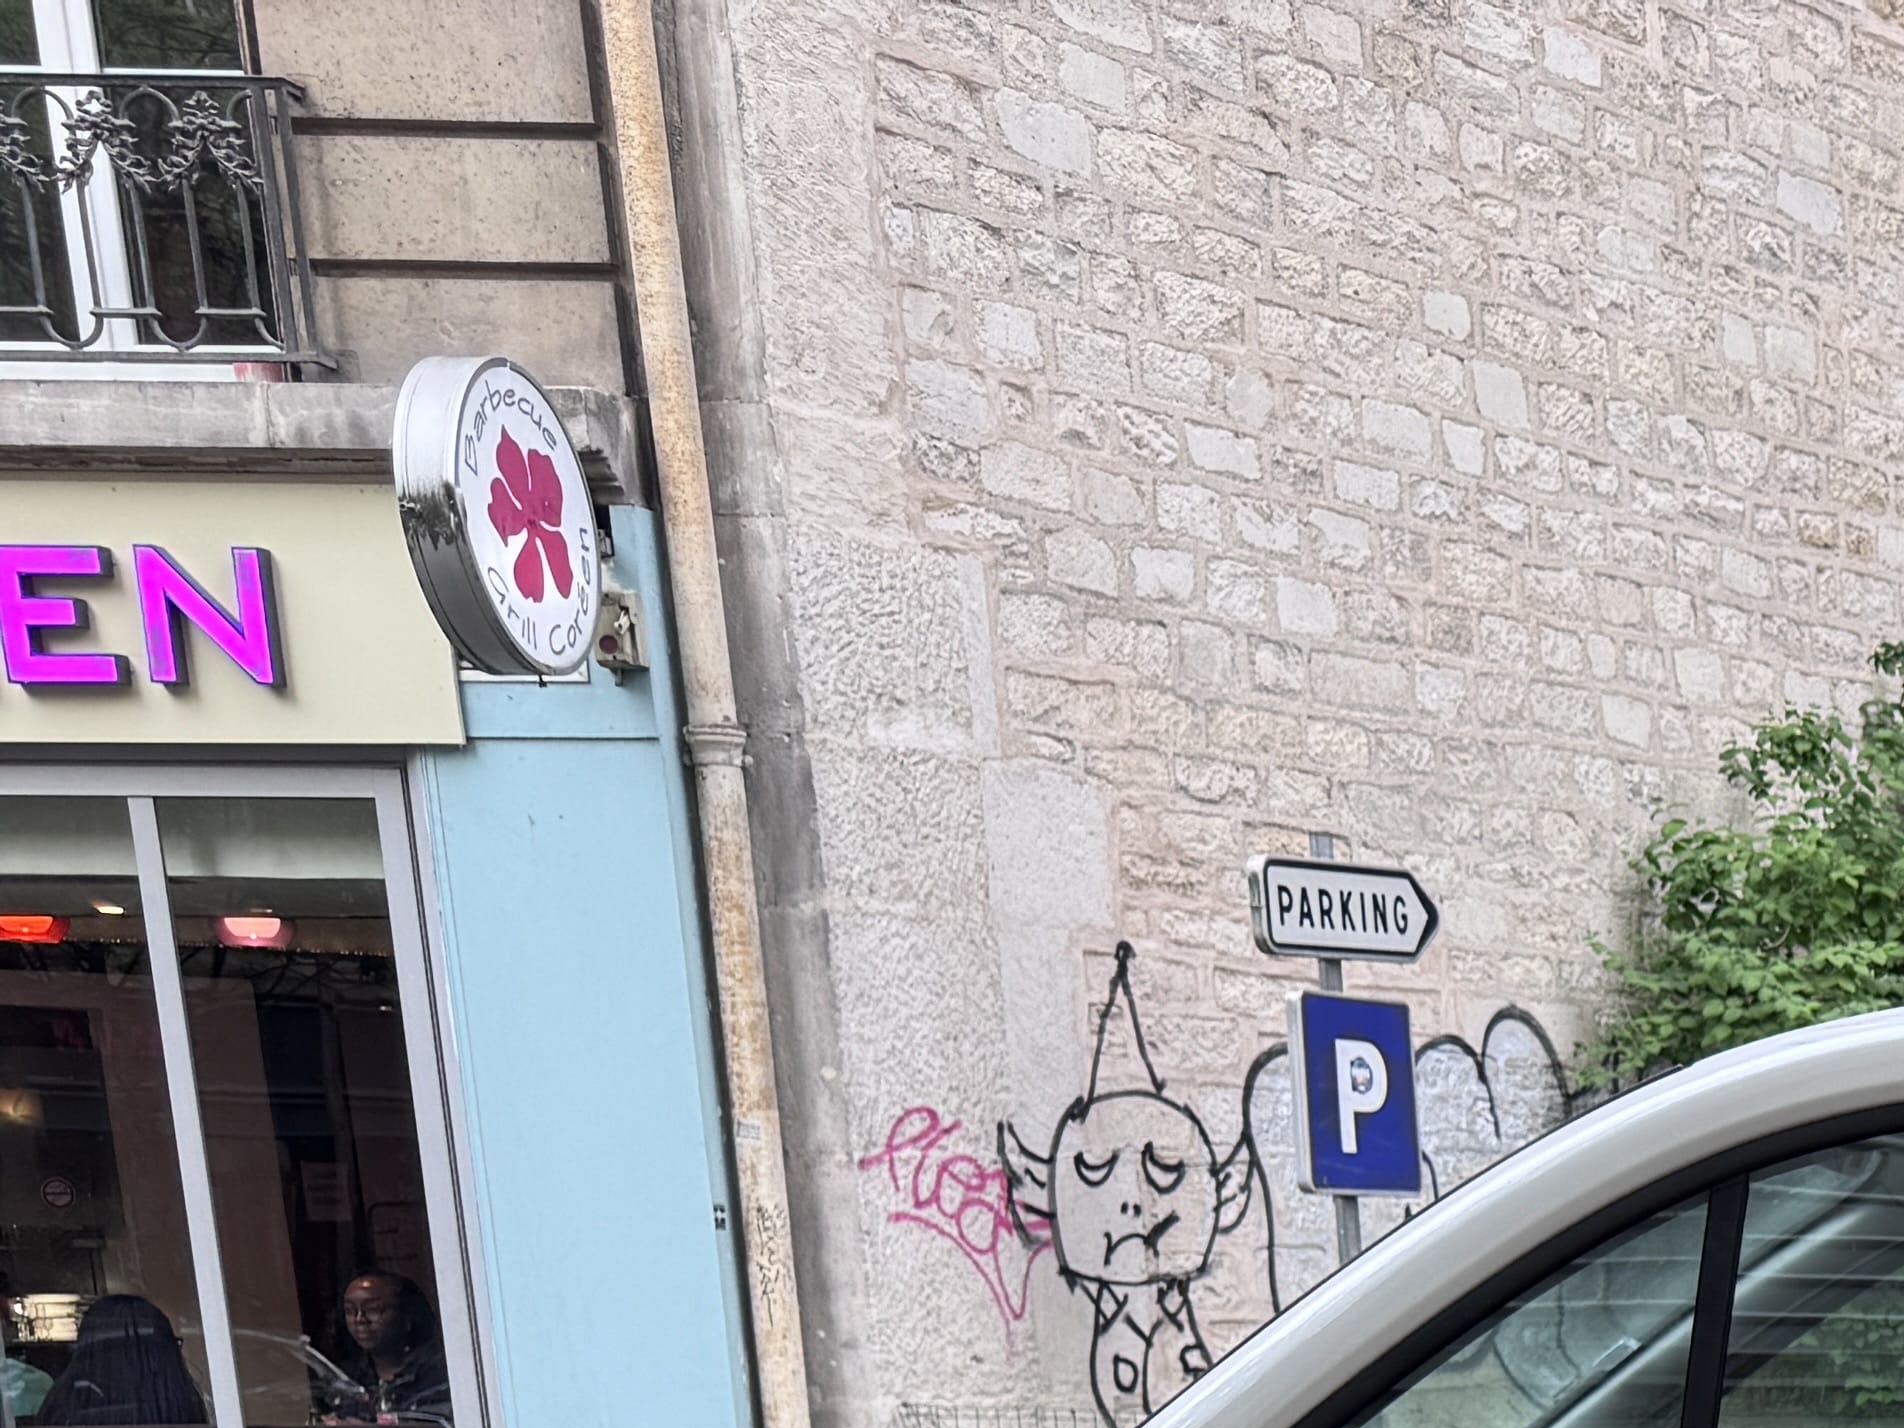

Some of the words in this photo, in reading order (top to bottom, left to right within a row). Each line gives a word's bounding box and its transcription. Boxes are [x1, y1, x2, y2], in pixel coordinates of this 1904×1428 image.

[464, 379, 558, 477] Barbecue
[487, 566, 538, 651] Grill
[549, 527, 592, 656] Coréen
[1276, 884, 1410, 936] PARKING
[1334, 1037, 1389, 1155] P
